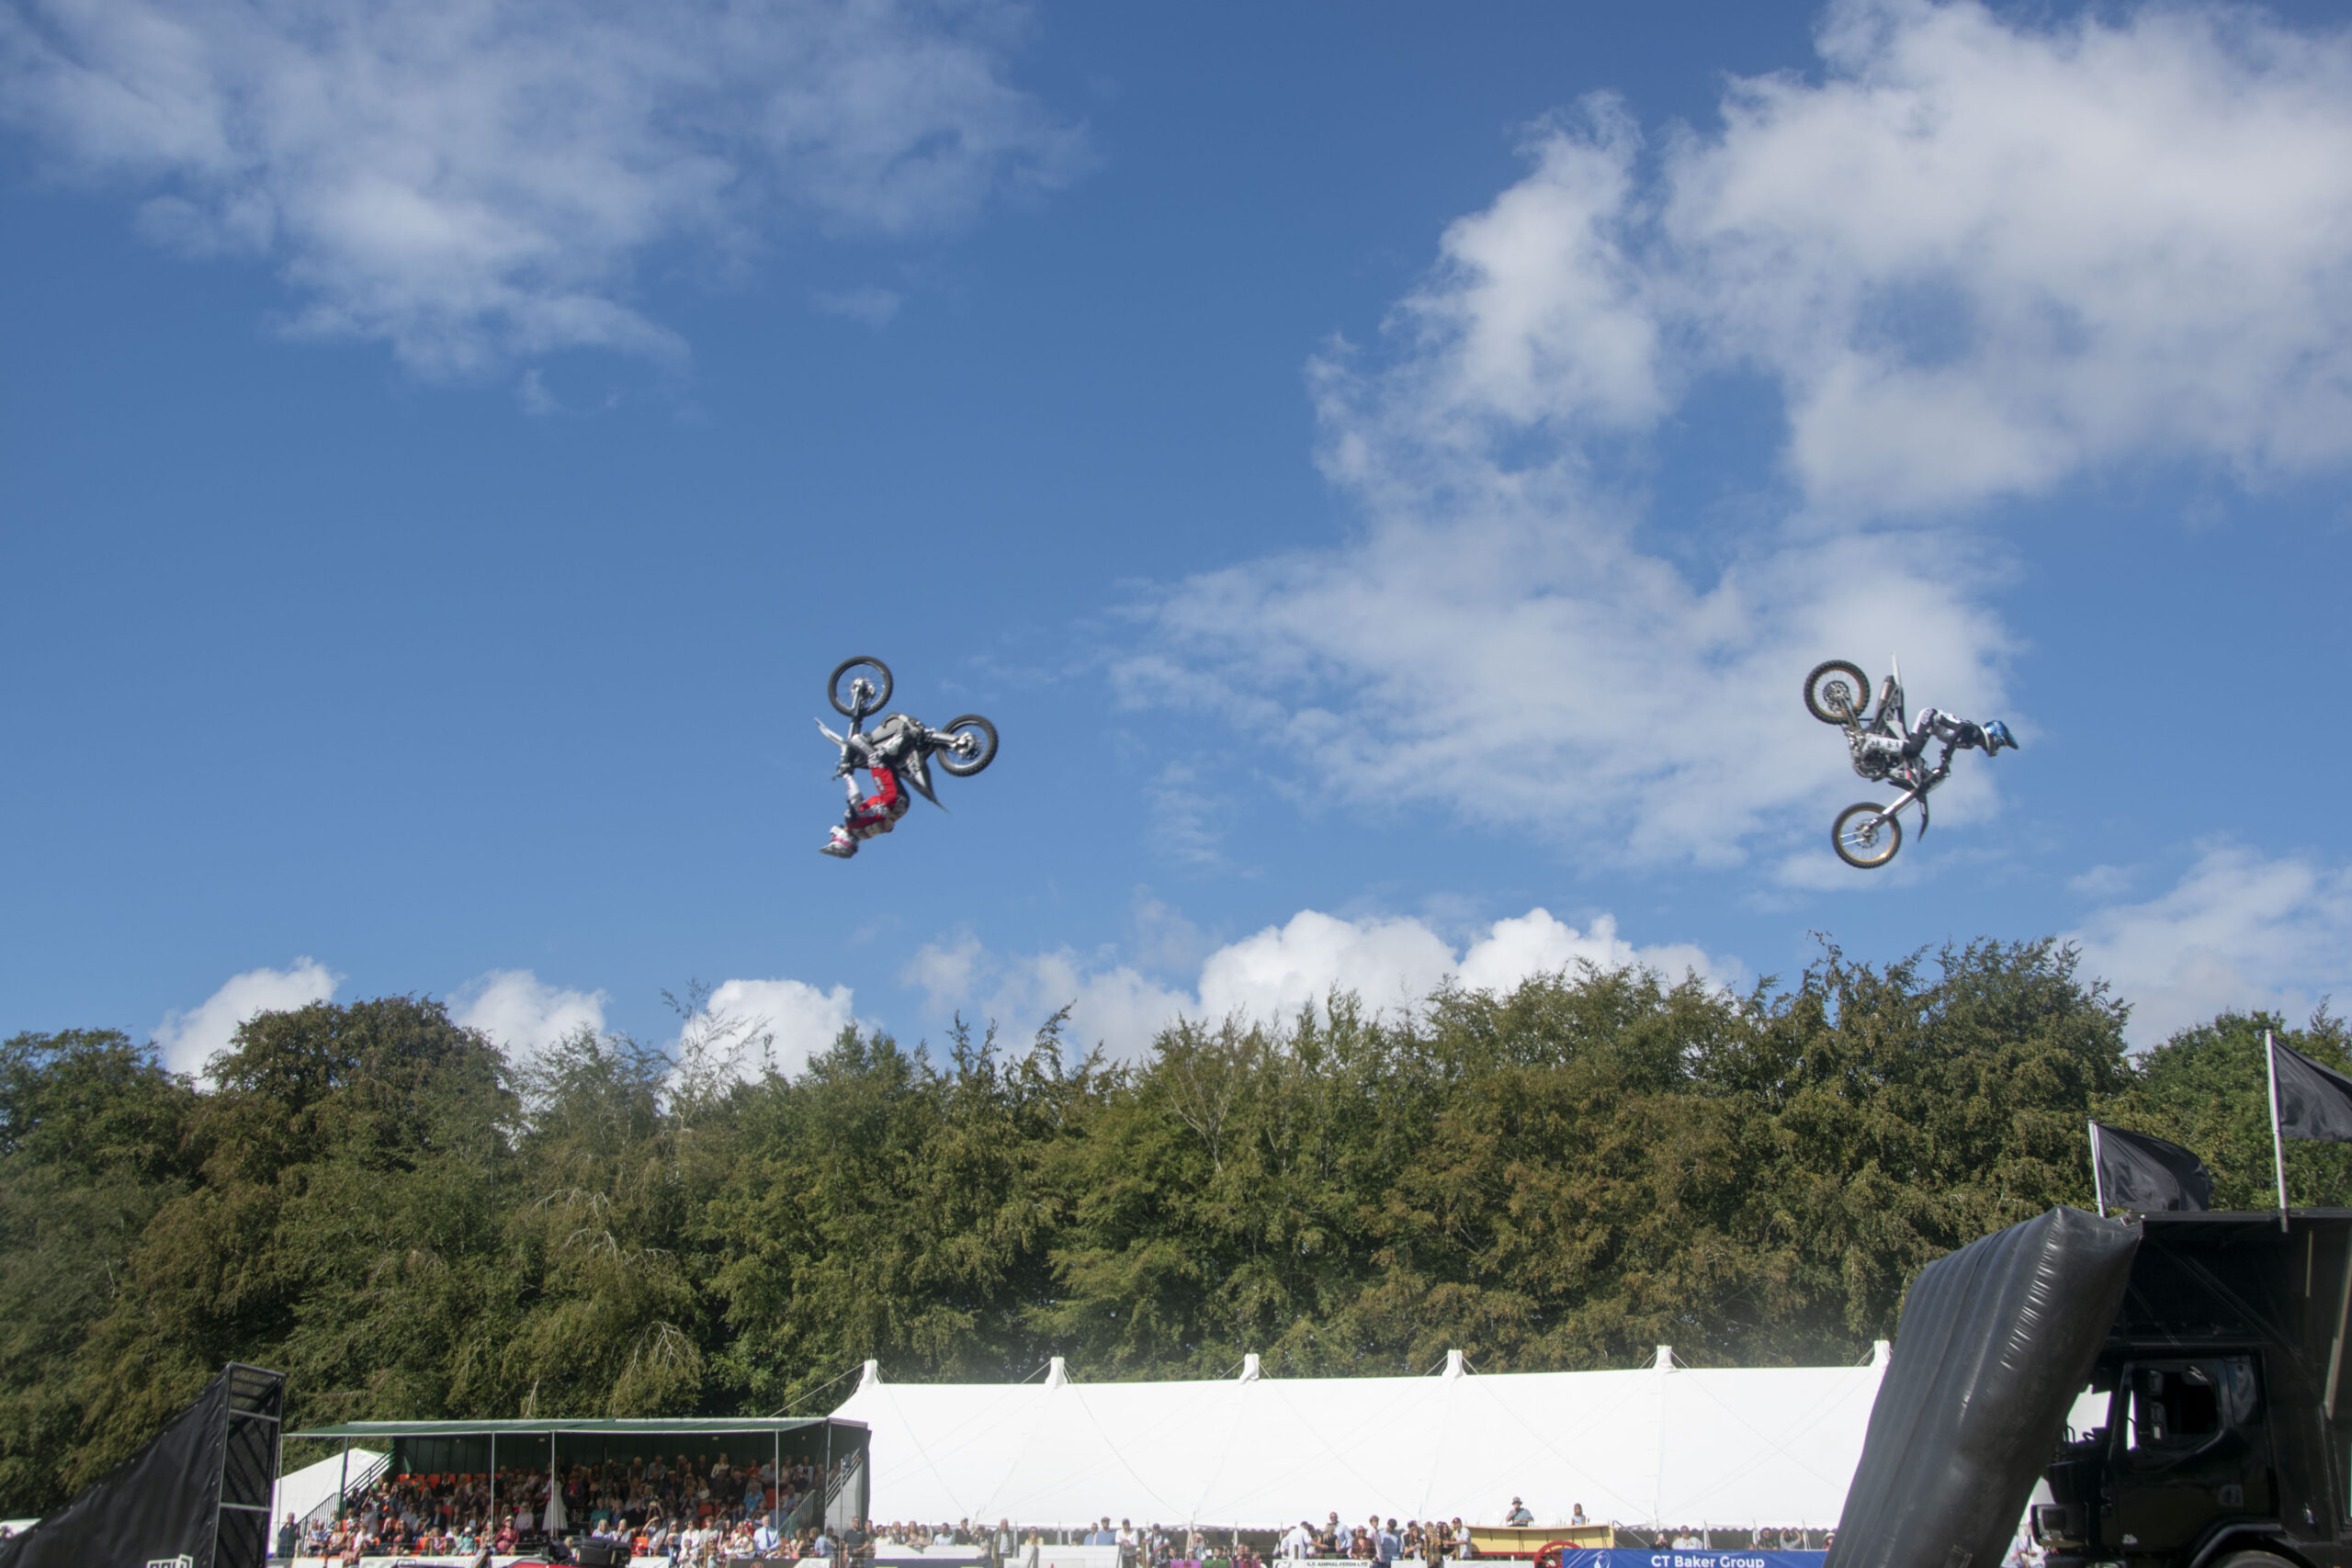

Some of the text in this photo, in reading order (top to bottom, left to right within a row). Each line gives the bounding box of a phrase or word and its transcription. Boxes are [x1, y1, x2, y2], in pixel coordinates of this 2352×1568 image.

[1650, 1555, 1765, 1568] CT Baker Group
